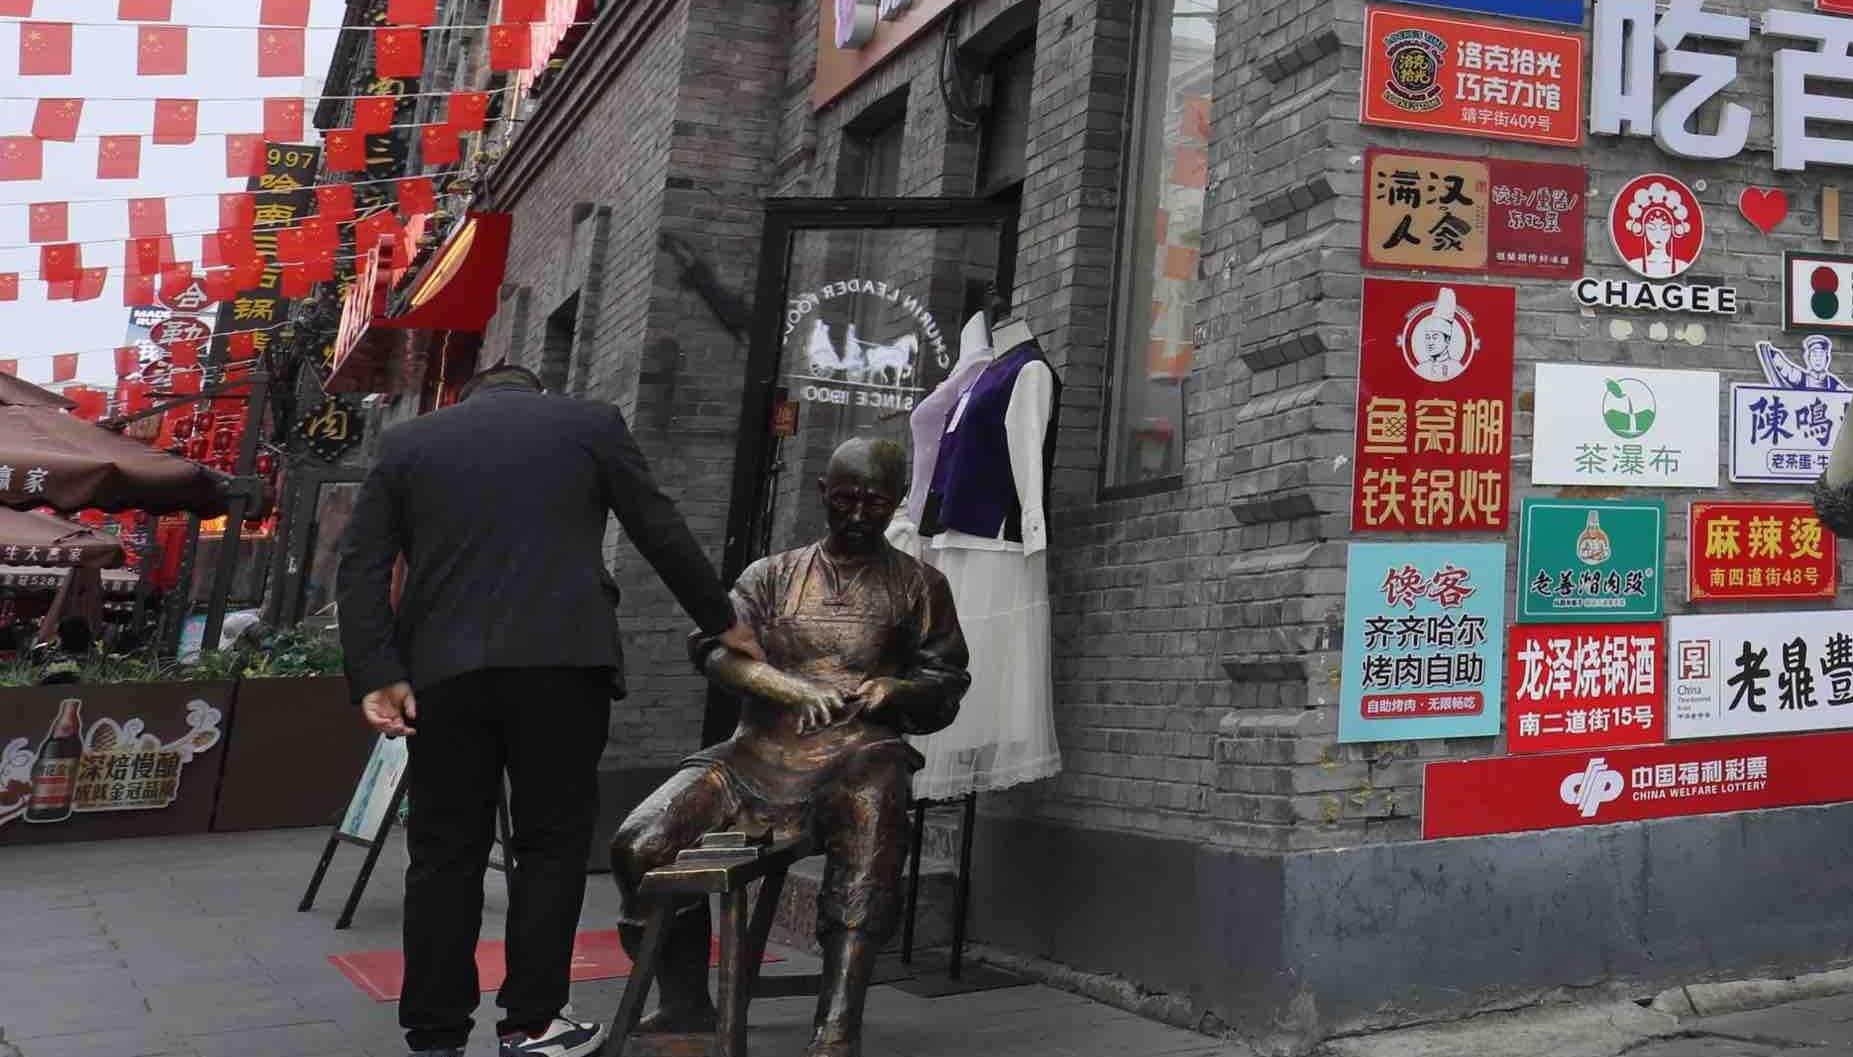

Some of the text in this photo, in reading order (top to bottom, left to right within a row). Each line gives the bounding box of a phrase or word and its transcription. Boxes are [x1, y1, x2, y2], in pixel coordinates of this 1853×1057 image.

[1456, 41, 1562, 80] 洛克拾光
[1455, 74, 1561, 112] 巧克力馆
[1462, 107, 1552, 133] 靖宇街409号
[266, 148, 314, 169] 997
[1376, 170, 1473, 208] 满汉
[1576, 279, 1737, 313] CHAGEE
[1749, 396, 1851, 446] 陳鳴
[1576, 443, 1682, 476] 茶瀑布
[1362, 468, 1501, 526] 铁锅炖
[1705, 516, 1823, 559] 麻辣烫
[1382, 564, 1475, 611] 馋客
[1710, 567, 1819, 587] 南四道街48号
[1365, 615, 1486, 650] 齐齐哈尔
[1362, 653, 1483, 688] 烤肉自助
[1517, 636, 1656, 702] 龙泽烧锅酒
[1677, 684, 1701, 695] China
[1519, 705, 1653, 737] 南二道街15号
[1631, 756, 1768, 790] 中国福利彩票
[1632, 779, 1767, 802] CHINA WELFARE LOTTERY
